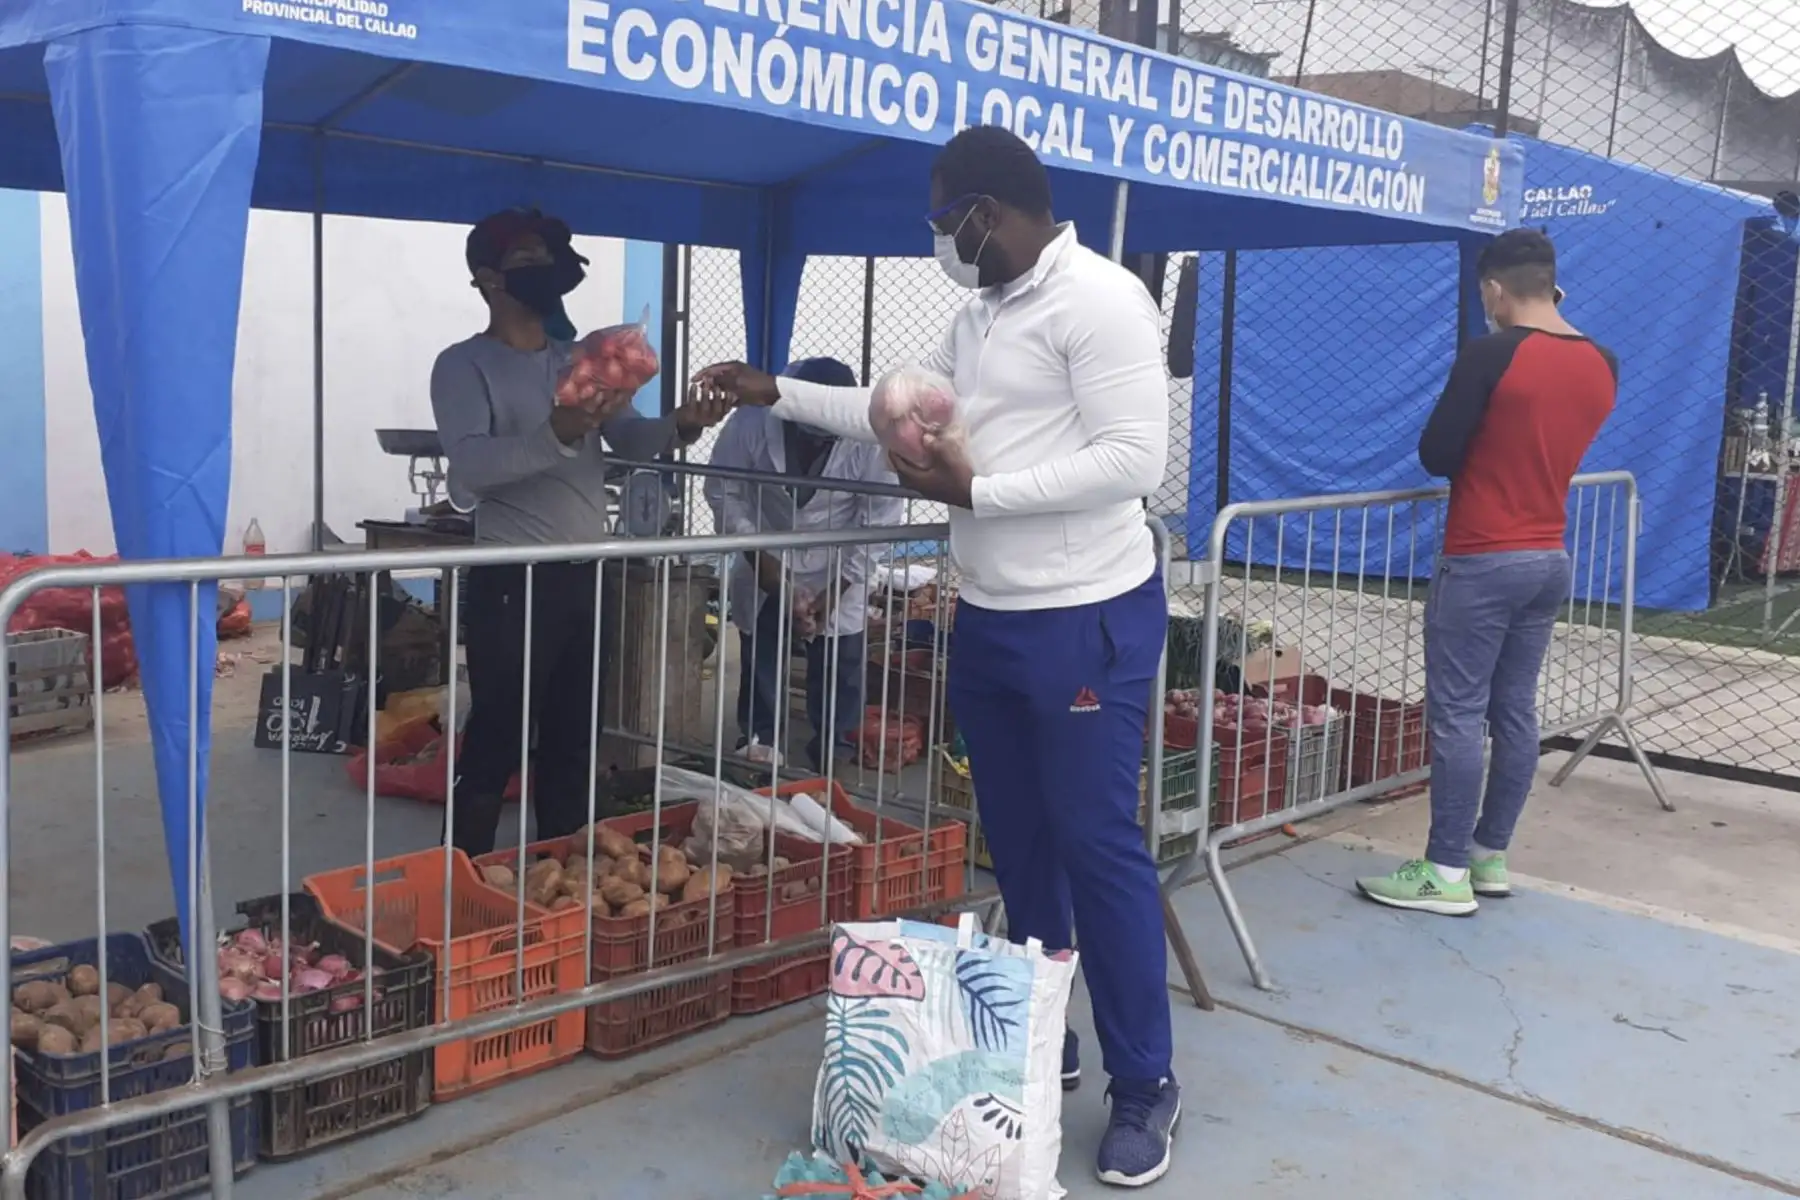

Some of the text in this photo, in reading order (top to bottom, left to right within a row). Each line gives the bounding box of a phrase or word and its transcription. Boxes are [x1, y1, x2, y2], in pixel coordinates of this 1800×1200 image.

[242, 1, 417, 39] PROVINCIAL DEL CALLAO
[567, 0, 1425, 215] ECONÓMICO LOCAL Y COMERCIALIZACIÓN
[965, 13, 1158, 111] GENERAL
[1171, 67, 1215, 125] DE
[1224, 80, 1403, 160] DESARROLLO
[1524, 185, 1592, 202] CALLAO
